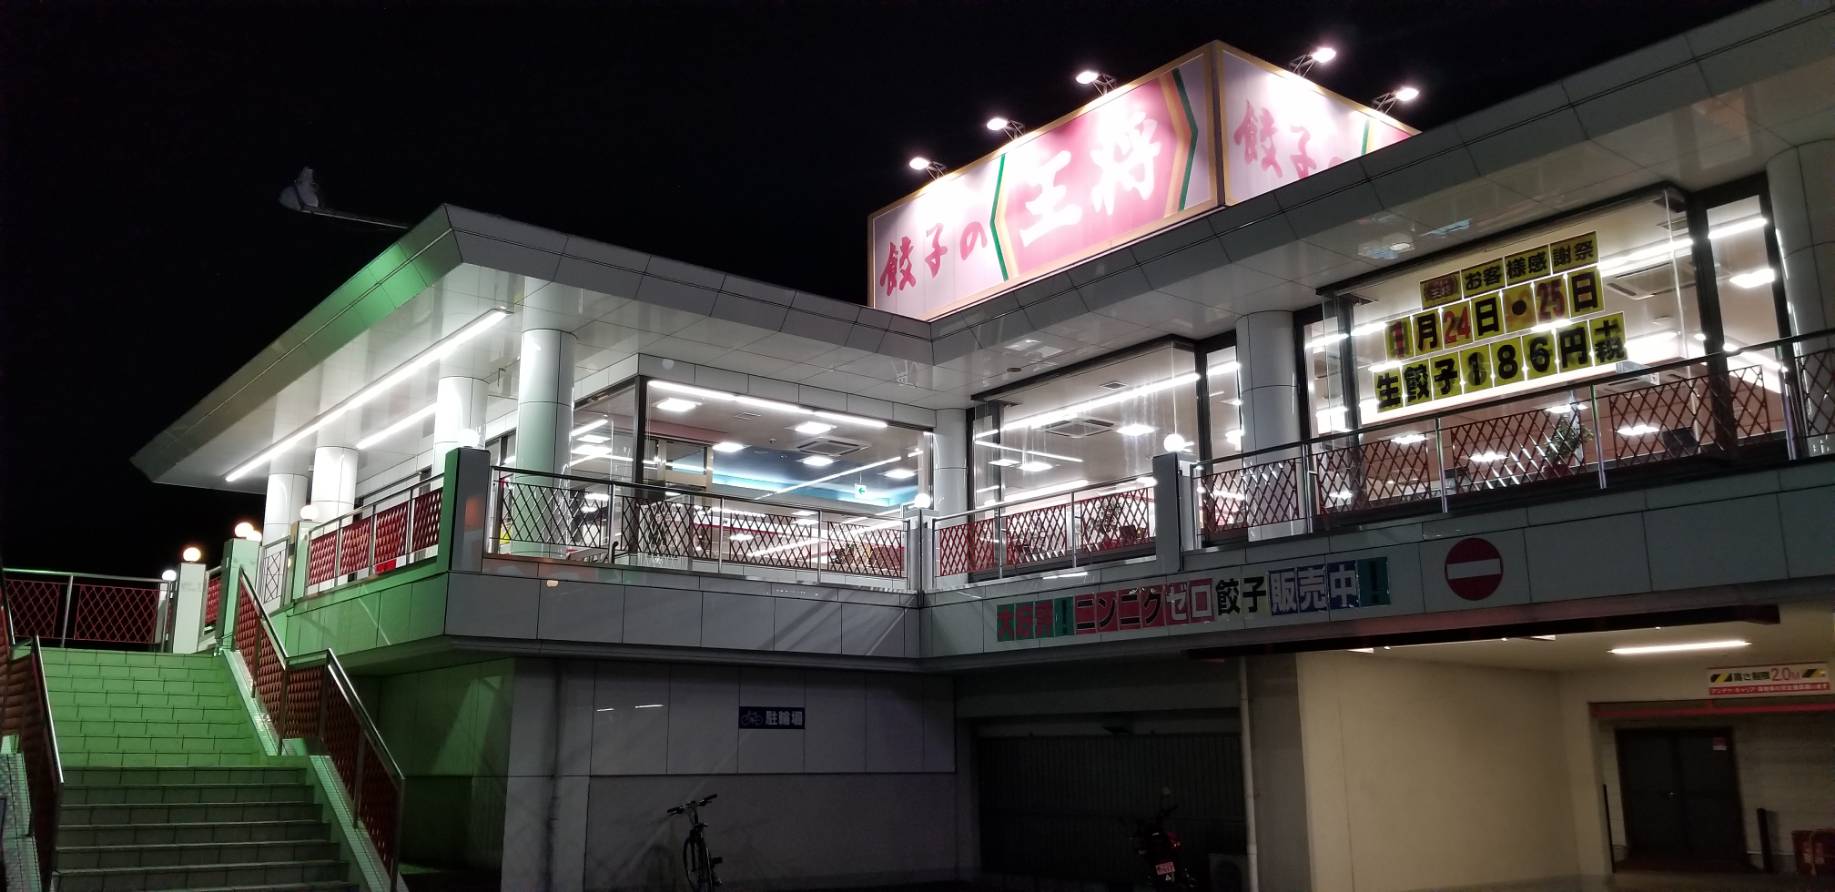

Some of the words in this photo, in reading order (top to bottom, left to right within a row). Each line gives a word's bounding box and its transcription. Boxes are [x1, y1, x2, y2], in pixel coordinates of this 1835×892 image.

[1465, 238, 1594, 290] お客様感謝祭
